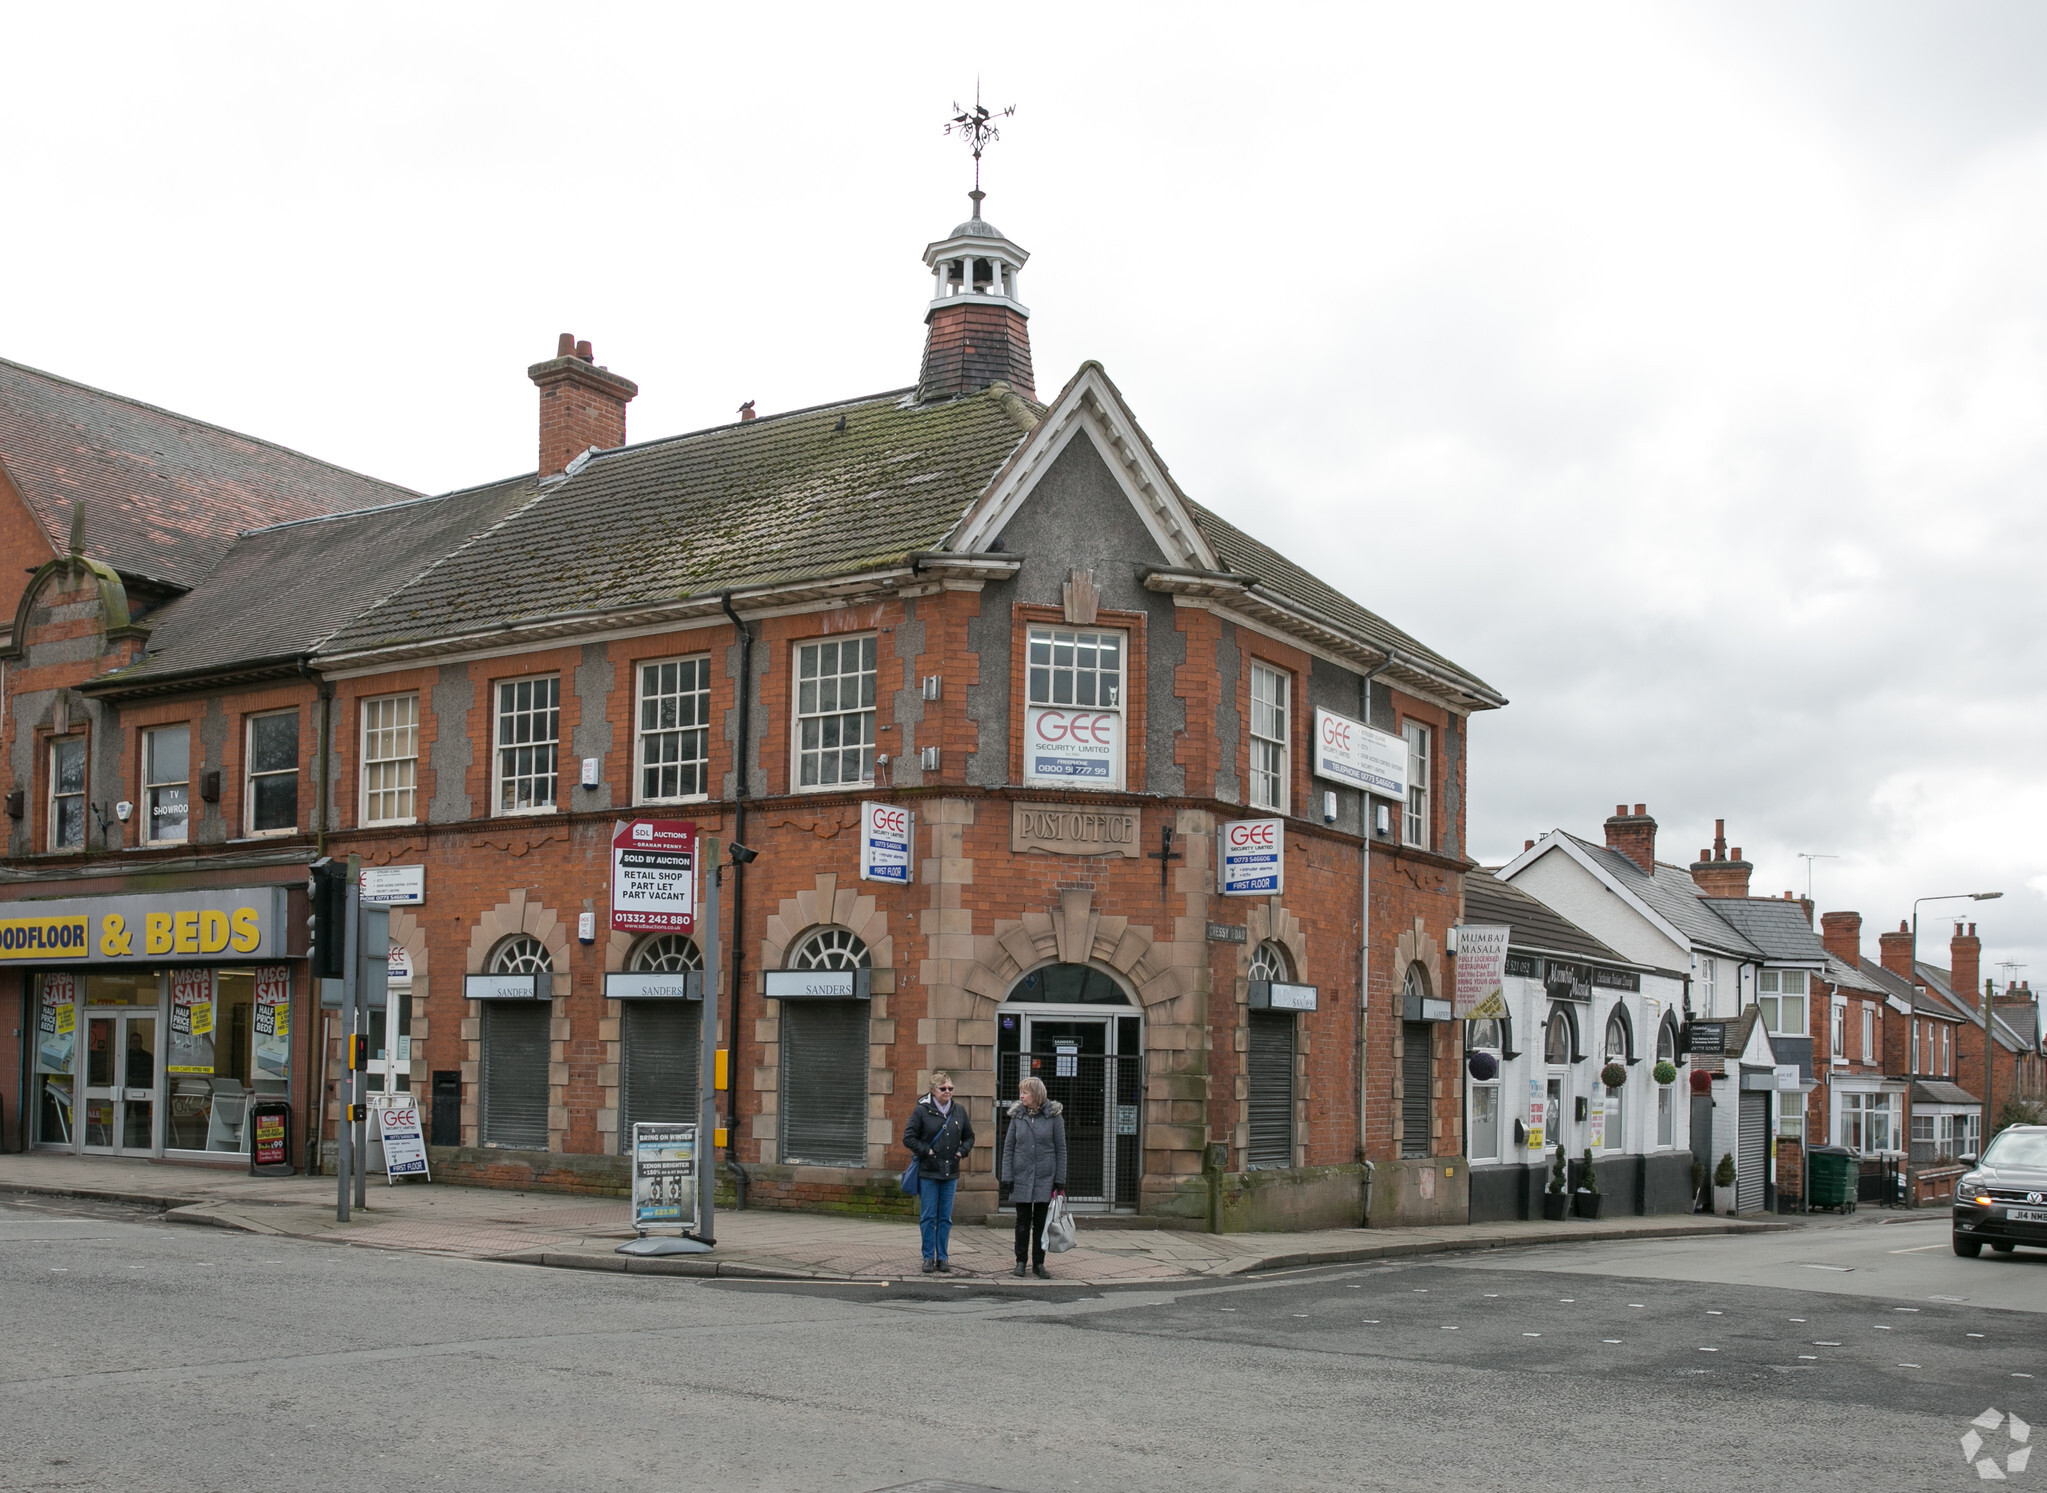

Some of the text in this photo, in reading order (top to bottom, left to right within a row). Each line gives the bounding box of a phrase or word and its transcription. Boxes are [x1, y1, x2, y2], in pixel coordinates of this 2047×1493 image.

[1036, 711, 1110, 744] GEE
[1322, 717, 1351, 751] GEE
[1035, 743, 1076, 752] SECURITY
[1078, 746, 1110, 754] LIMITED
[1038, 764, 1107, 776] 0800 91 777 99
[1332, 762, 1360, 779] TELEPHONE
[169, 790, 180, 799] TV
[873, 808, 905, 833] GEE
[1020, 812, 1133, 844] POST OFFICE
[635, 829, 687, 840] SDL AUCTIONS
[1231, 824, 1273, 846] GEE
[624, 854, 690, 866] SOLD BY AUCTION
[624, 870, 683, 881] RETAIL SHOP
[874, 866, 902, 877] FIRST FLOOR
[631, 881, 674, 891] PART LET
[1233, 877, 1270, 890] FIRST FLOOR
[622, 890, 685, 901] PART VACANT
[615, 913, 690, 925] 01332 242 880
[101, 907, 261, 956] & BEDS
[1461, 933, 1505, 943] MUMBAI
[1461, 945, 1501, 954] MASALA
[1475, 955, 1500, 963] LICENSED
[43, 984, 74, 1006] SALE
[174, 982, 210, 1004] SALE
[497, 987, 534, 998] SANDERS
[641, 986, 683, 997] SANDERS
[805, 984, 852, 995] SANDERS
[175, 1006, 190, 1017] HALF
[258, 1004, 274, 1015] HALF
[173, 1014, 190, 1026] PRICE
[256, 1013, 275, 1025] PRICE
[172, 1022, 189, 1033] CARPETS
[256, 1023, 273, 1034] BEDS
[384, 1110, 416, 1126] GEE
[393, 1161, 423, 1172] FIRST FLOOR
[2014, 1211, 2028, 1220] J14
